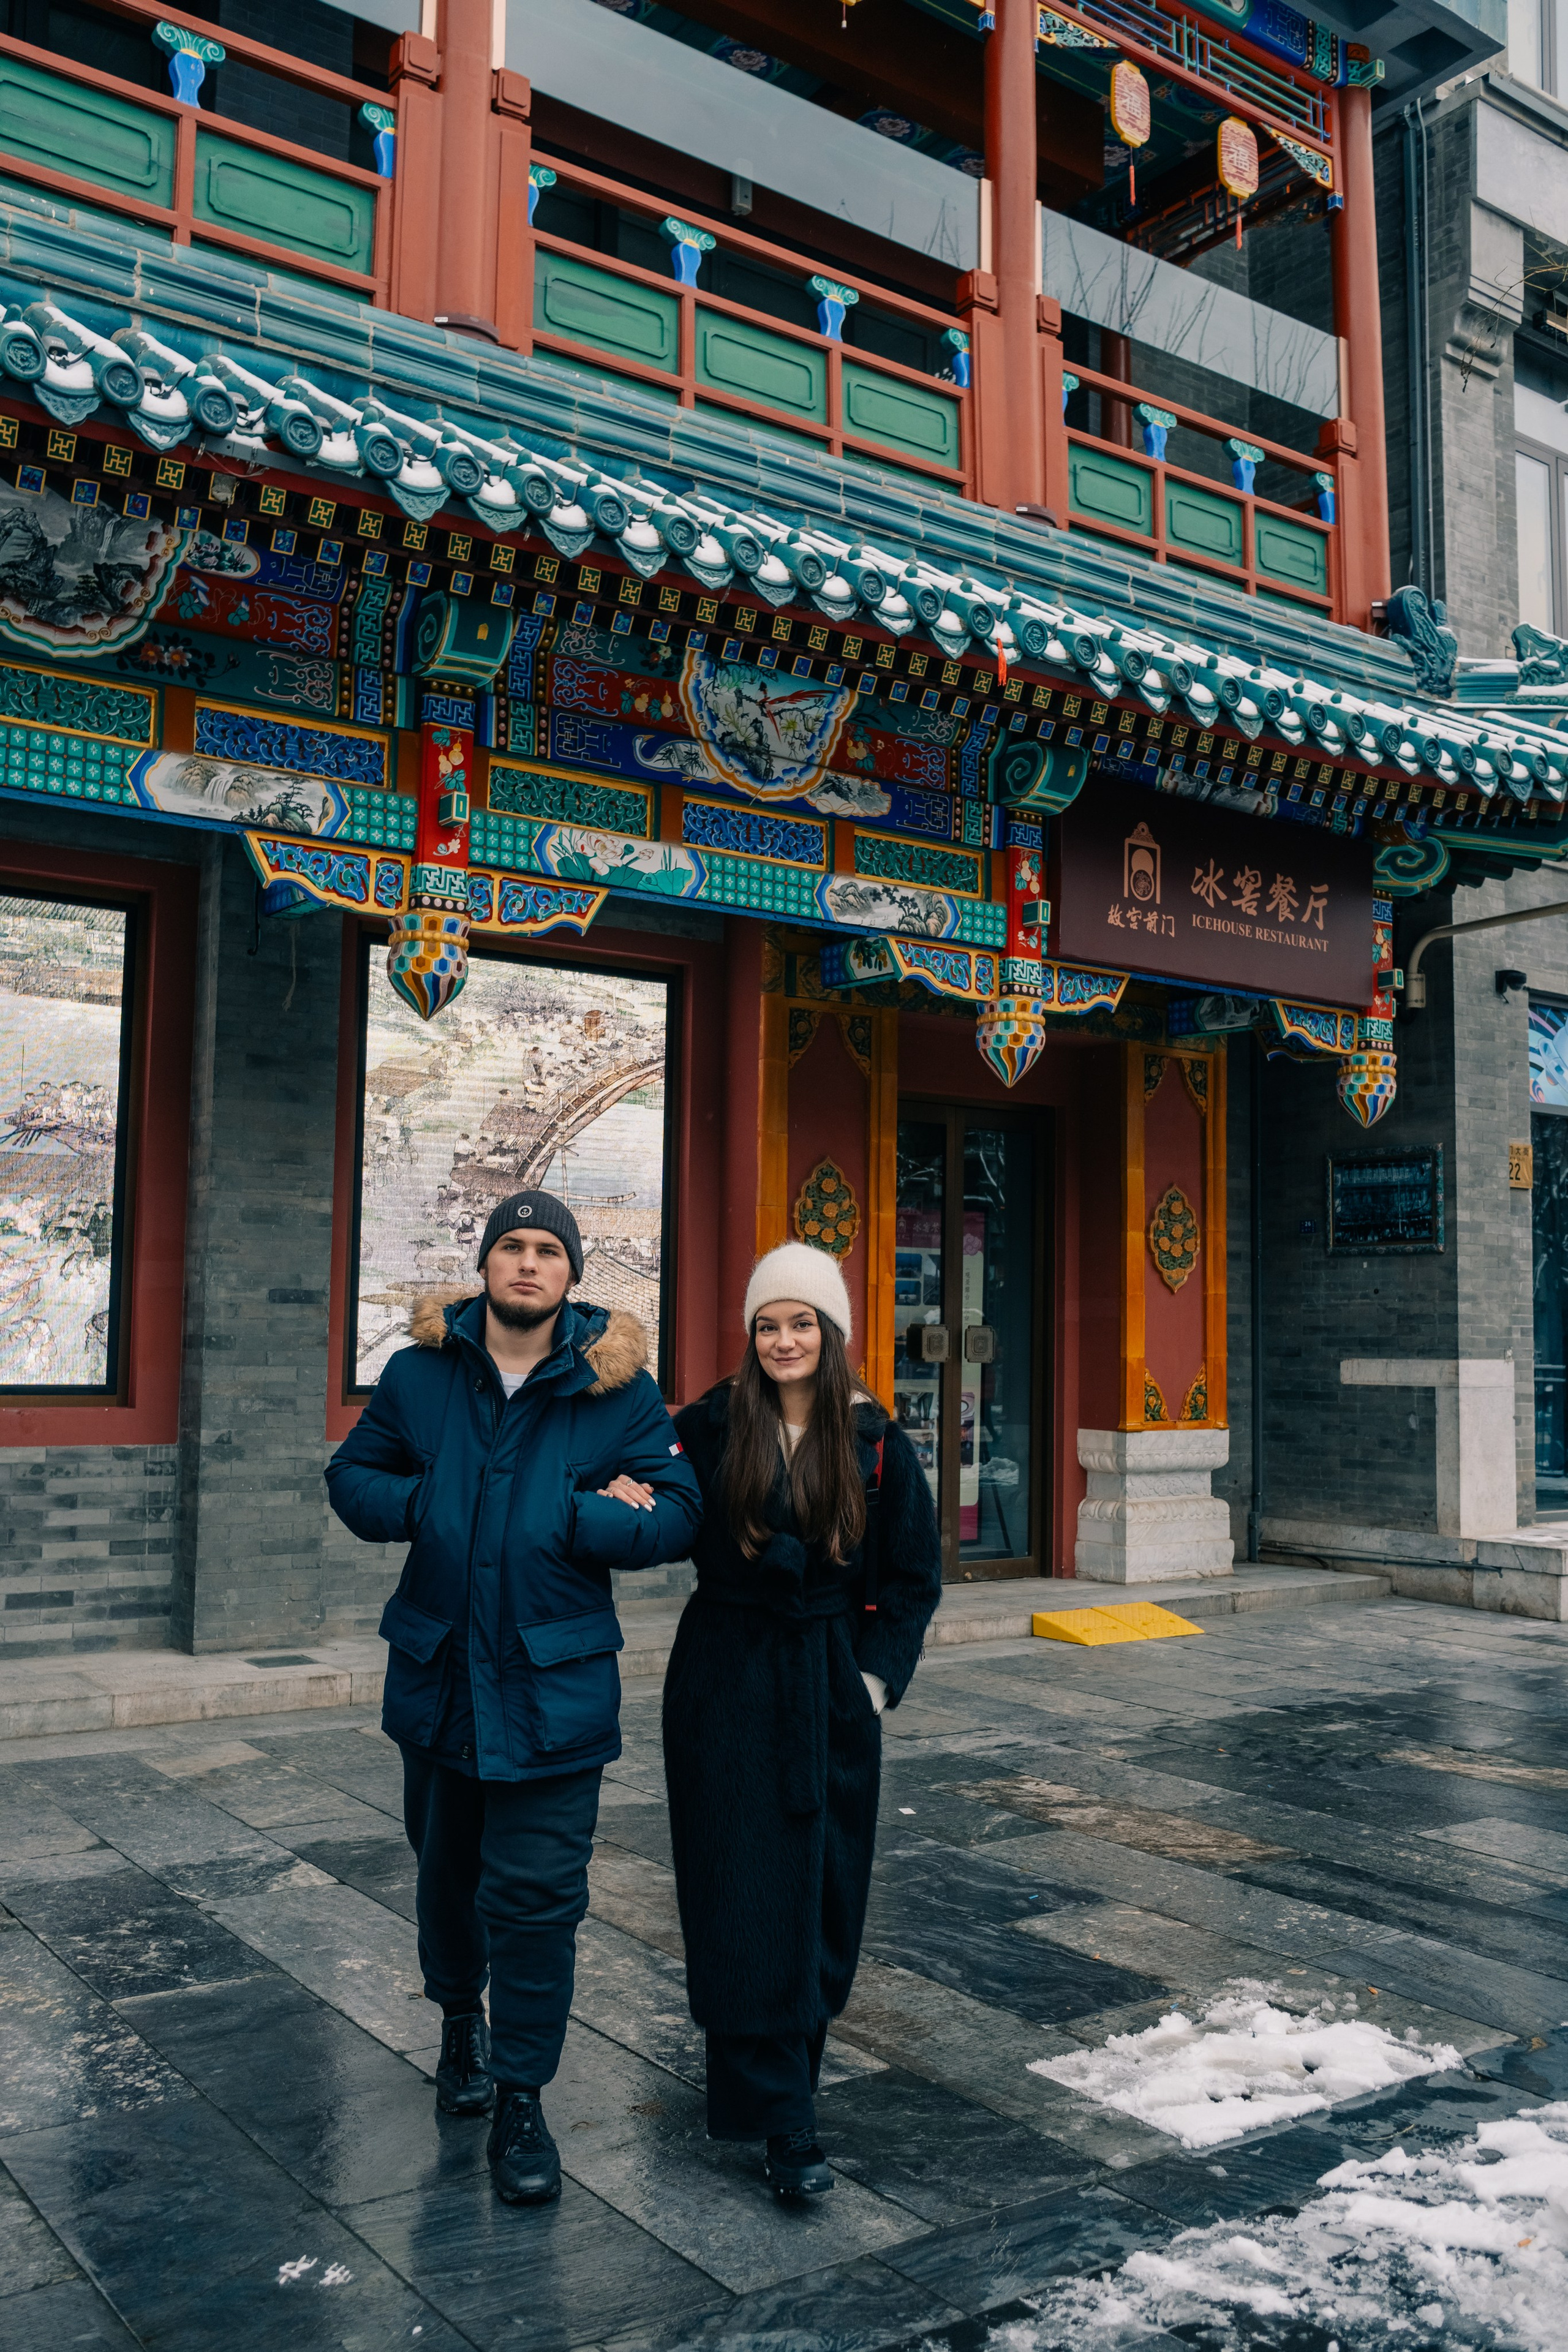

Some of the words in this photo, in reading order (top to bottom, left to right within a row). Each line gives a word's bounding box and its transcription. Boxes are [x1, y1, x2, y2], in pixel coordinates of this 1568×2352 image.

[1191, 858, 1329, 931] 冰窖餐厅
[1107, 903, 1175, 938] 故宫前门
[1192, 913, 1253, 938] ICEHOUSE
[1255, 926, 1329, 952] RESTAURANT
